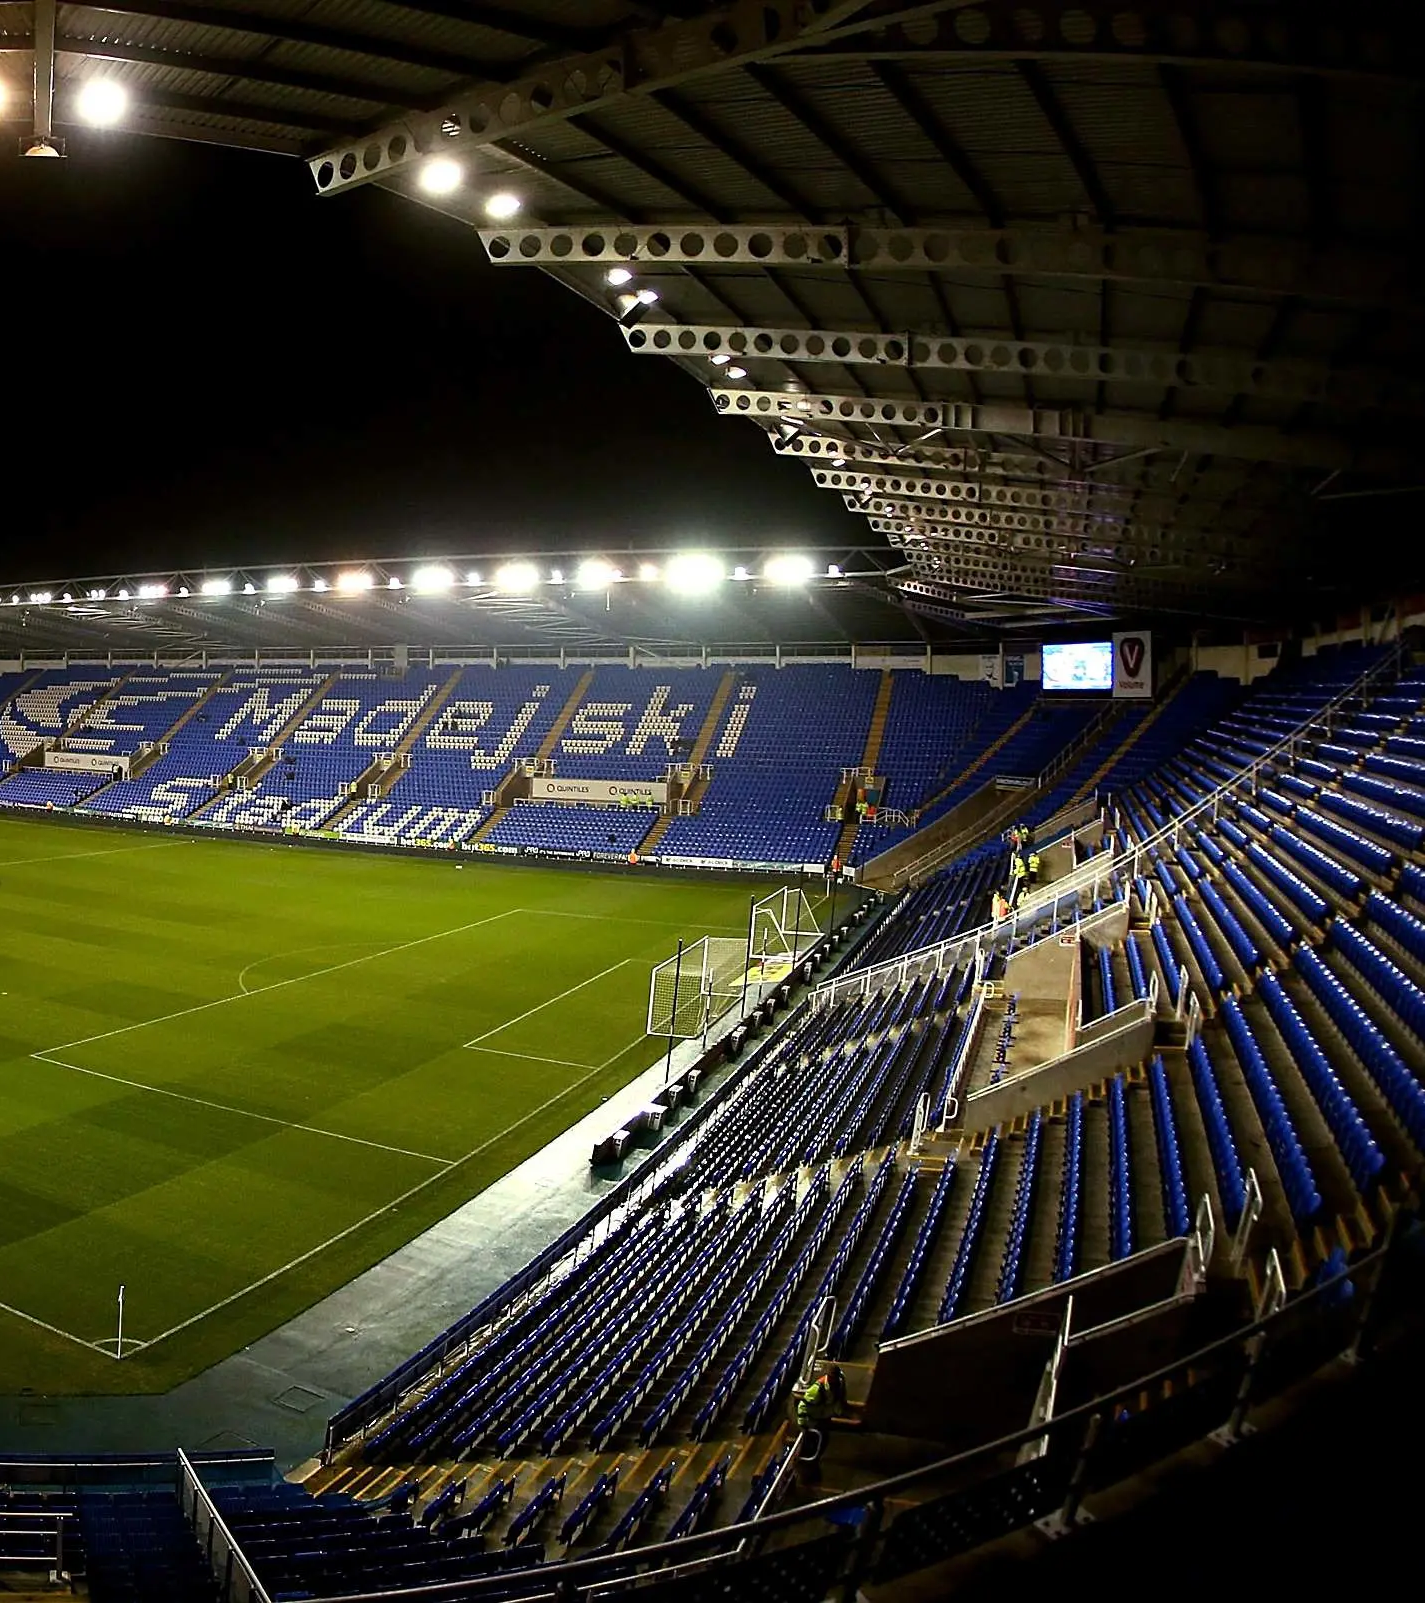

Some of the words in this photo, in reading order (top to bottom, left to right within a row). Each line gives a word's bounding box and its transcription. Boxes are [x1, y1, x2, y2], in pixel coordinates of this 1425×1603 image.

[215, 684, 757, 770] Madejski
[122, 778, 481, 842] Stadium
[619, 788, 652, 796] QUINTILES
